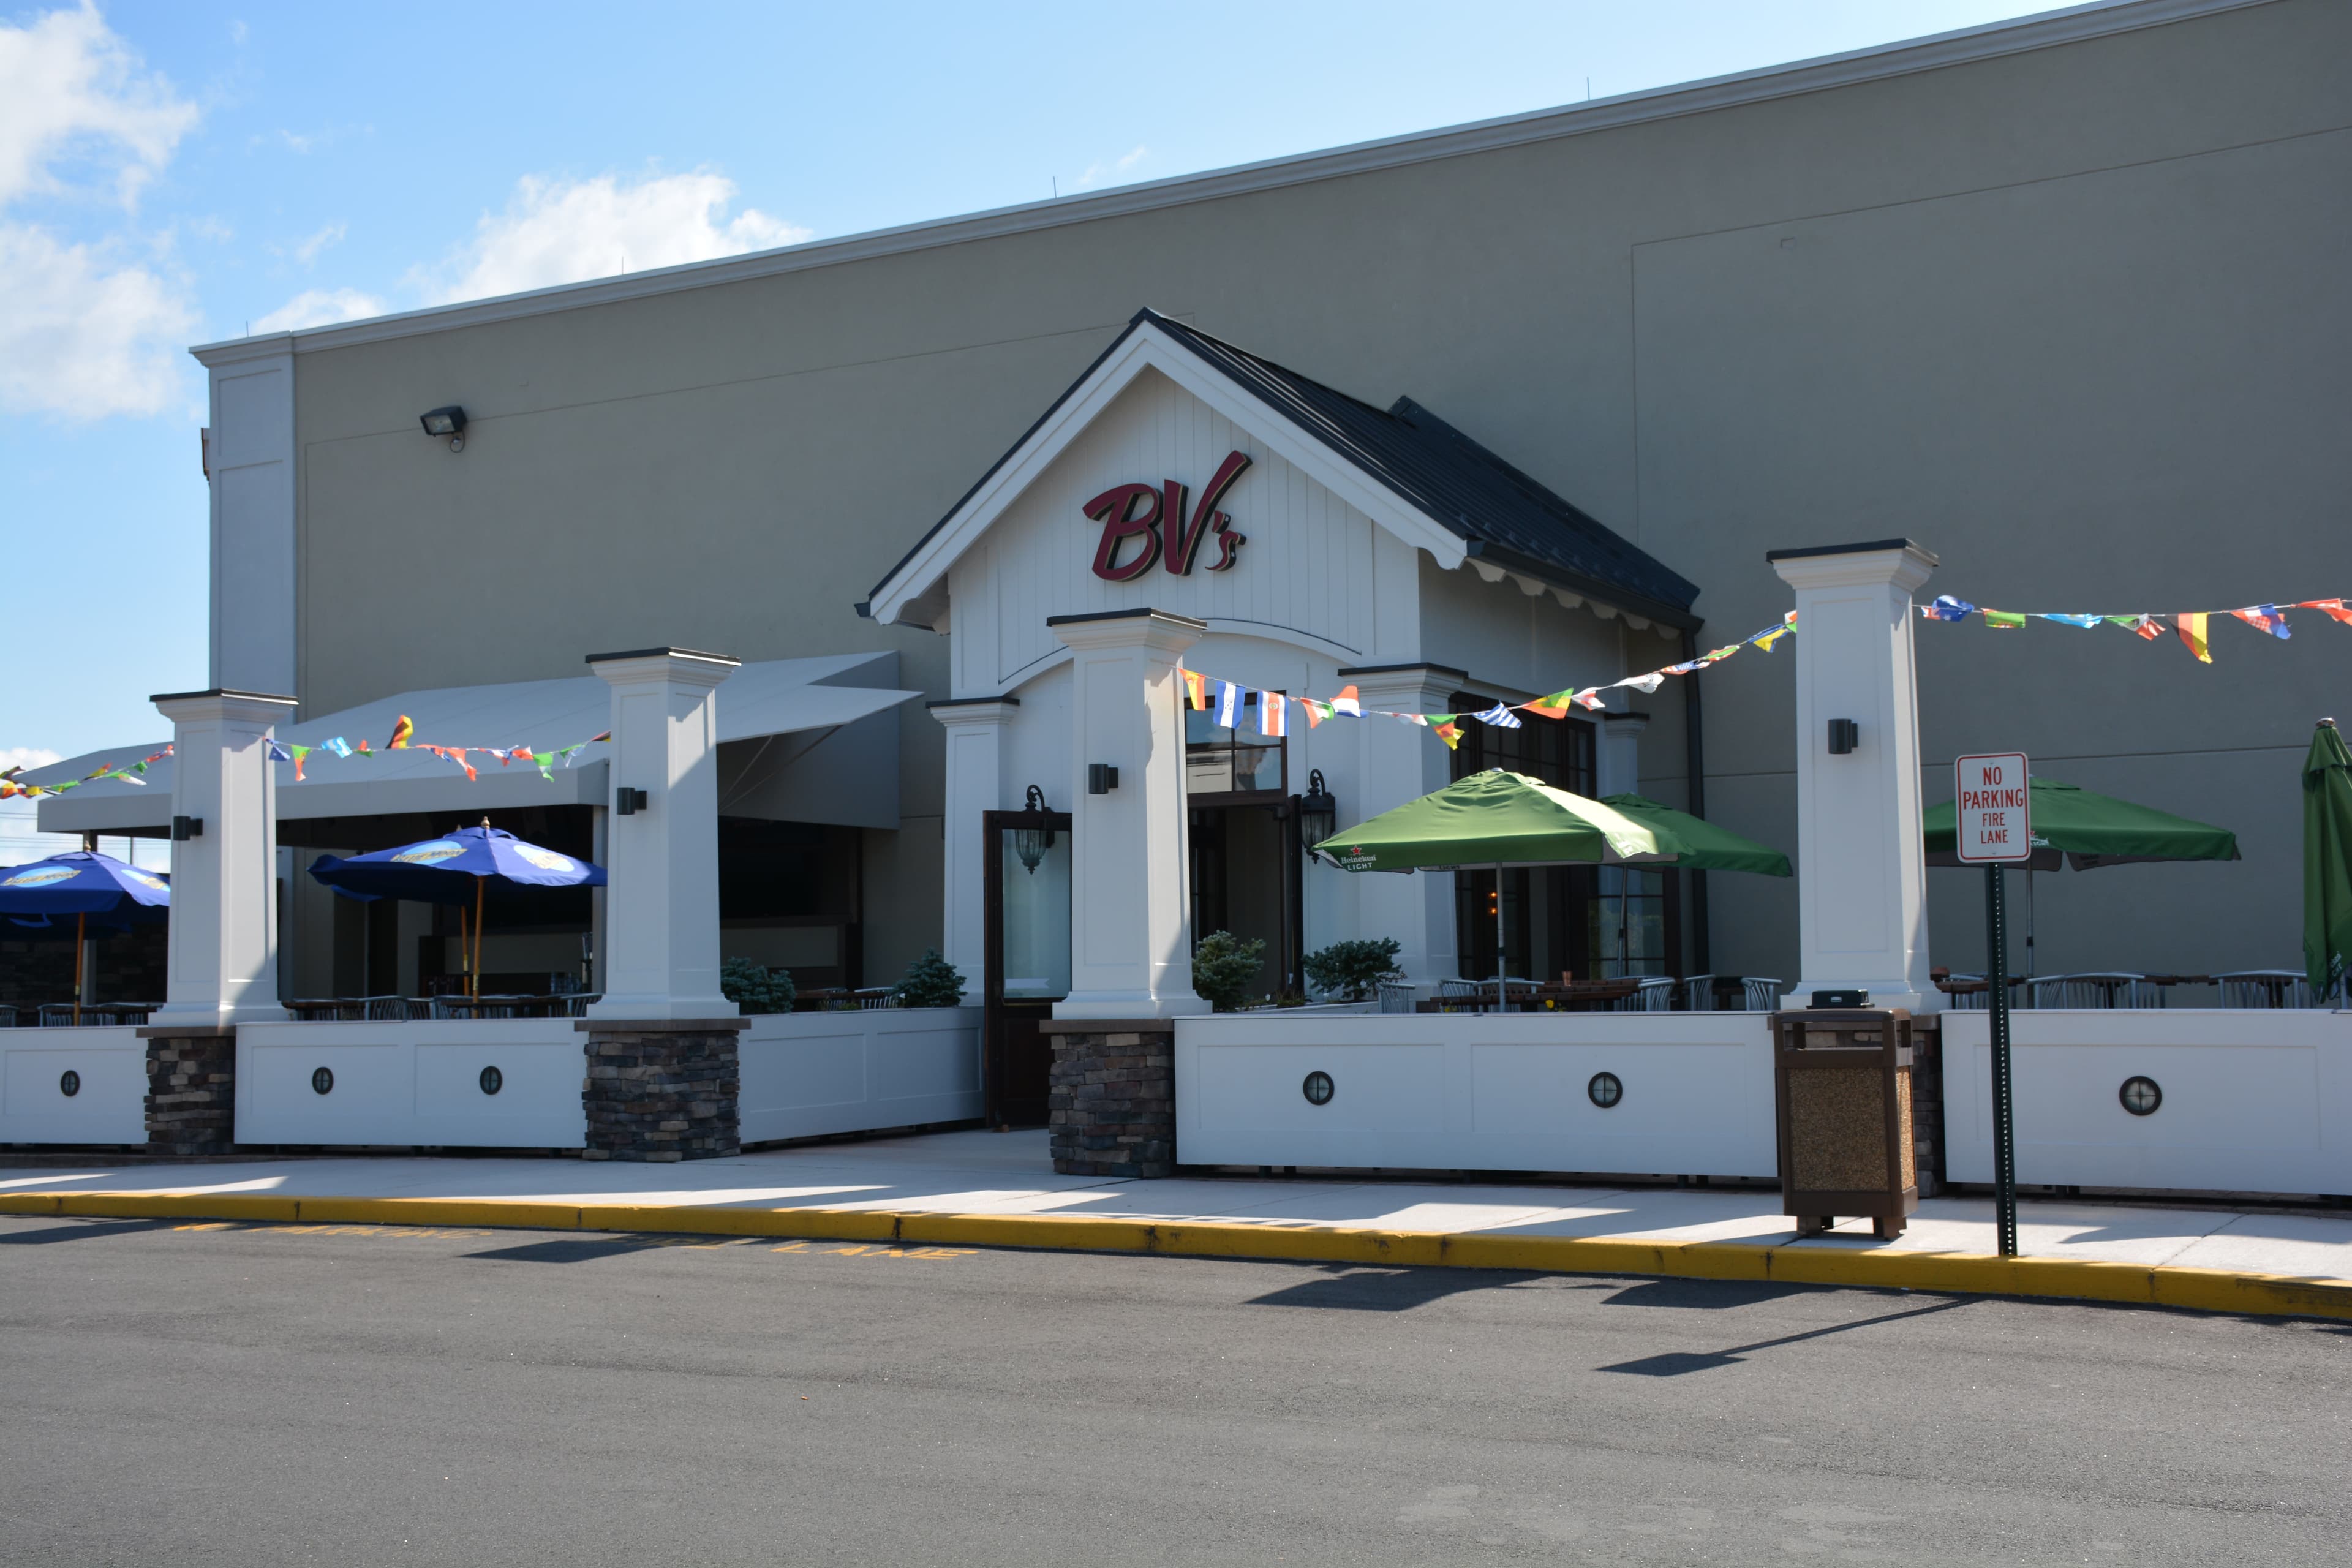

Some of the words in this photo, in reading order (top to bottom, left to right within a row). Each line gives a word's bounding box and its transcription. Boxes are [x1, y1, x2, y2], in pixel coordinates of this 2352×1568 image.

[1082, 450, 1253, 582] BV's
[1983, 767, 2002, 785] NO
[1963, 789, 2024, 810] PARKING
[1982, 812, 2006, 827] FIRE
[1980, 829, 2009, 845] LANE
[1341, 854, 1376, 864] Heineken
[769, 1242, 979, 1260] LANE
